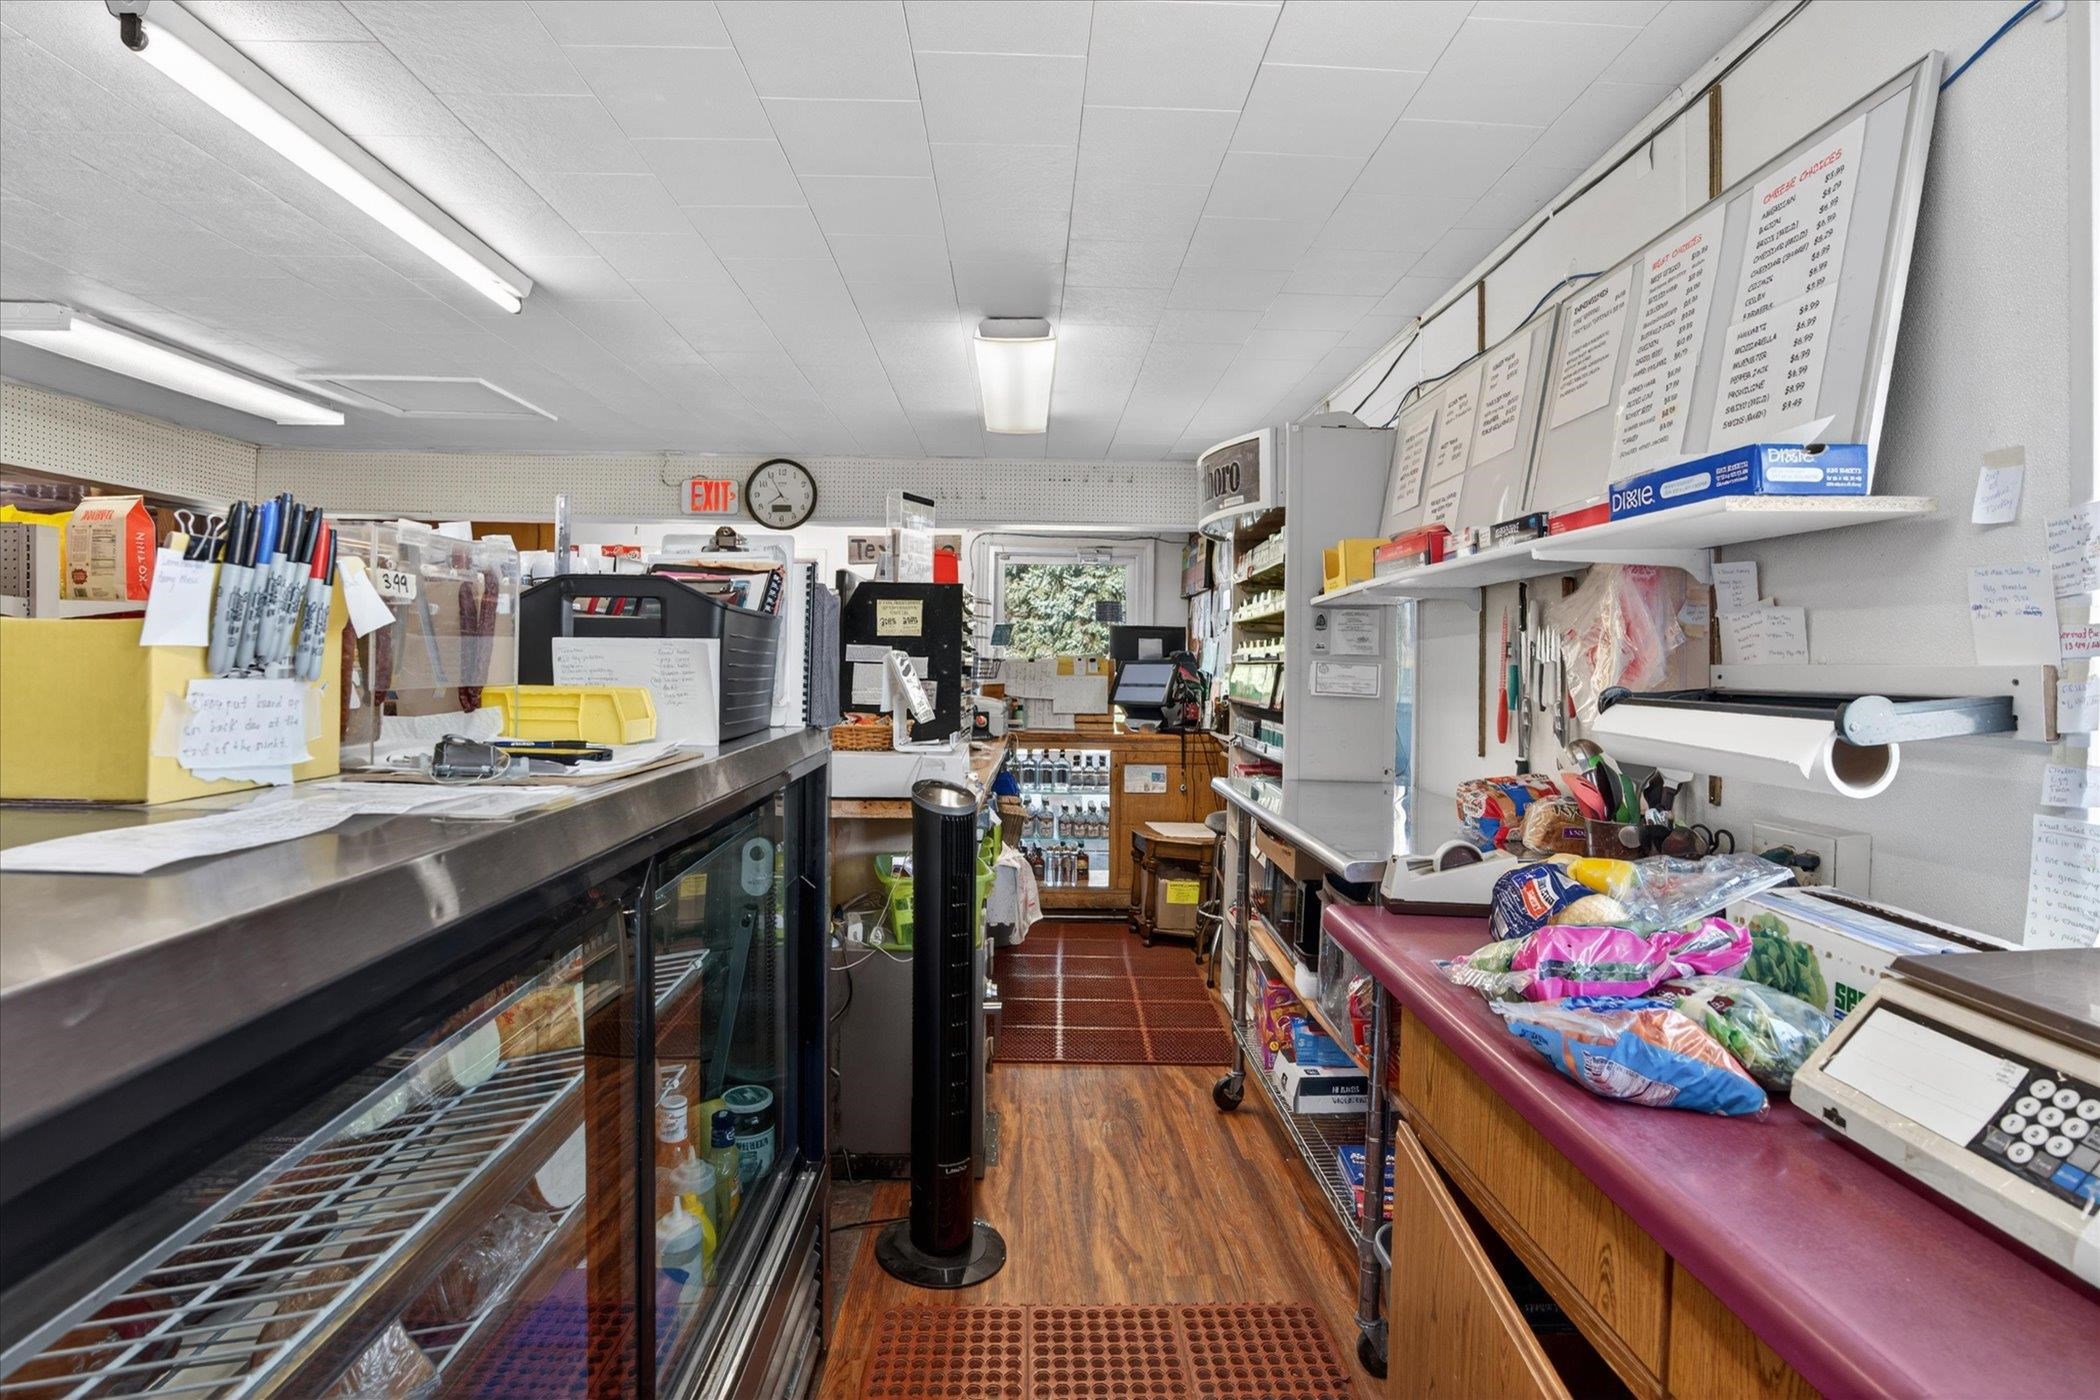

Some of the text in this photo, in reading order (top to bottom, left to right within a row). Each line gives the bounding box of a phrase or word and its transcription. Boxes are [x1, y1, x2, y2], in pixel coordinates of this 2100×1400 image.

[1799, 148, 1843, 183] CHOICES
[690, 481, 731, 512] EXIT
[2061, 1095, 2070, 1103] 8
[2085, 1105, 2095, 1113] 9
[2047, 1113, 2055, 1121] 5
[2070, 1124, 2080, 1132] 6
[2030, 1131, 2039, 1139] 2
[2054, 1142, 2064, 1150] 3
[2015, 1149, 2025, 1157] 0
